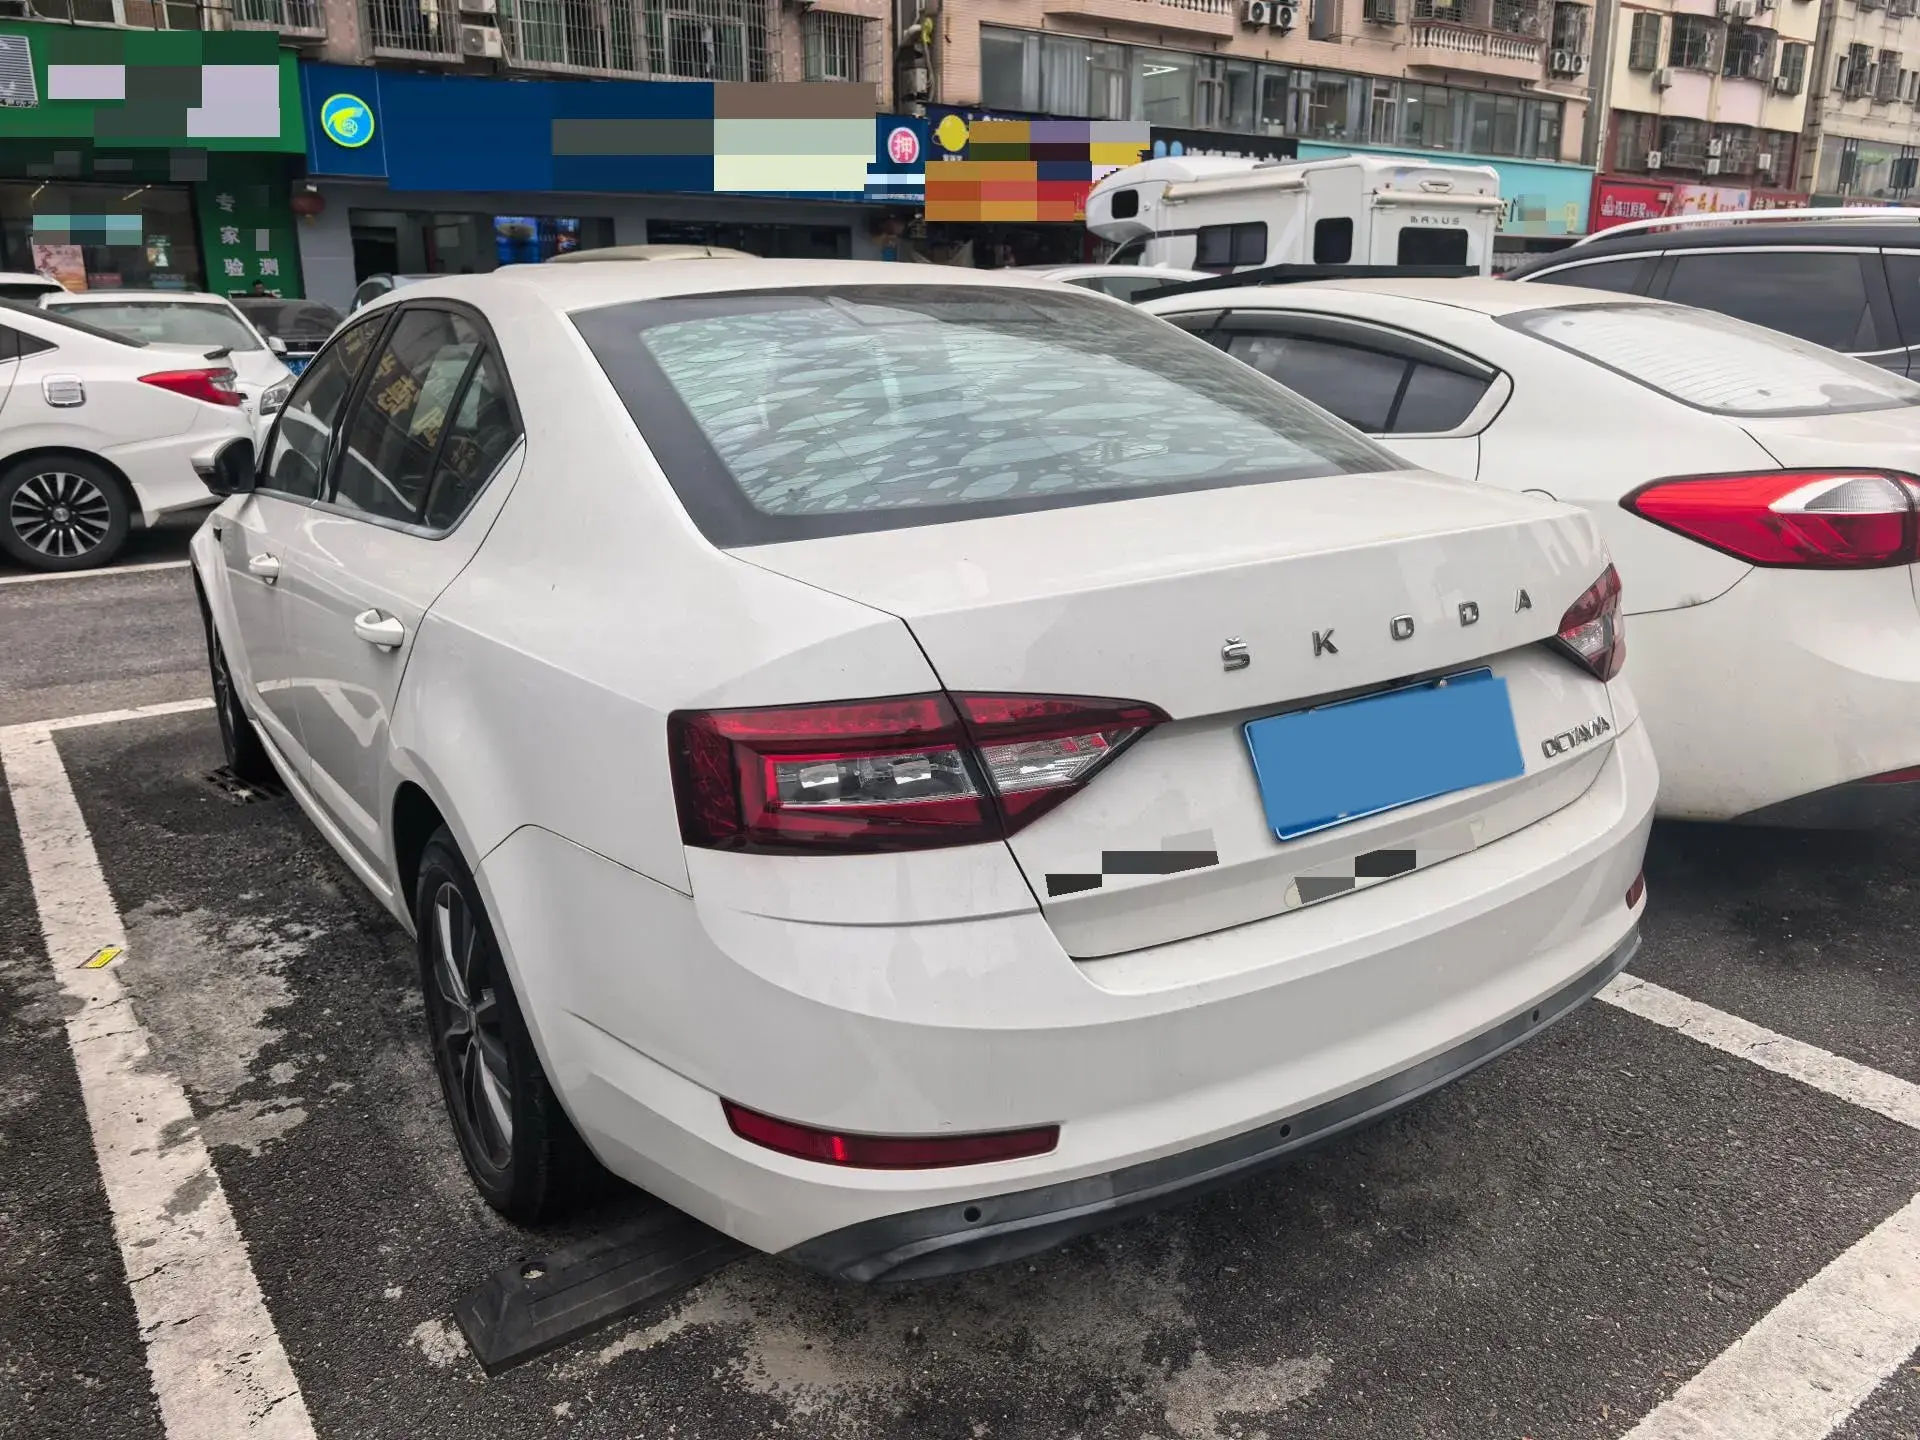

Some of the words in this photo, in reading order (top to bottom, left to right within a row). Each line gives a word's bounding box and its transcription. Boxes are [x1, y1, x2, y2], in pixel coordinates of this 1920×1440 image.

[893, 134, 914, 160] 押
[1220, 586, 1534, 672] ŠKODA
[1541, 715, 1611, 759] OCTAVIA
